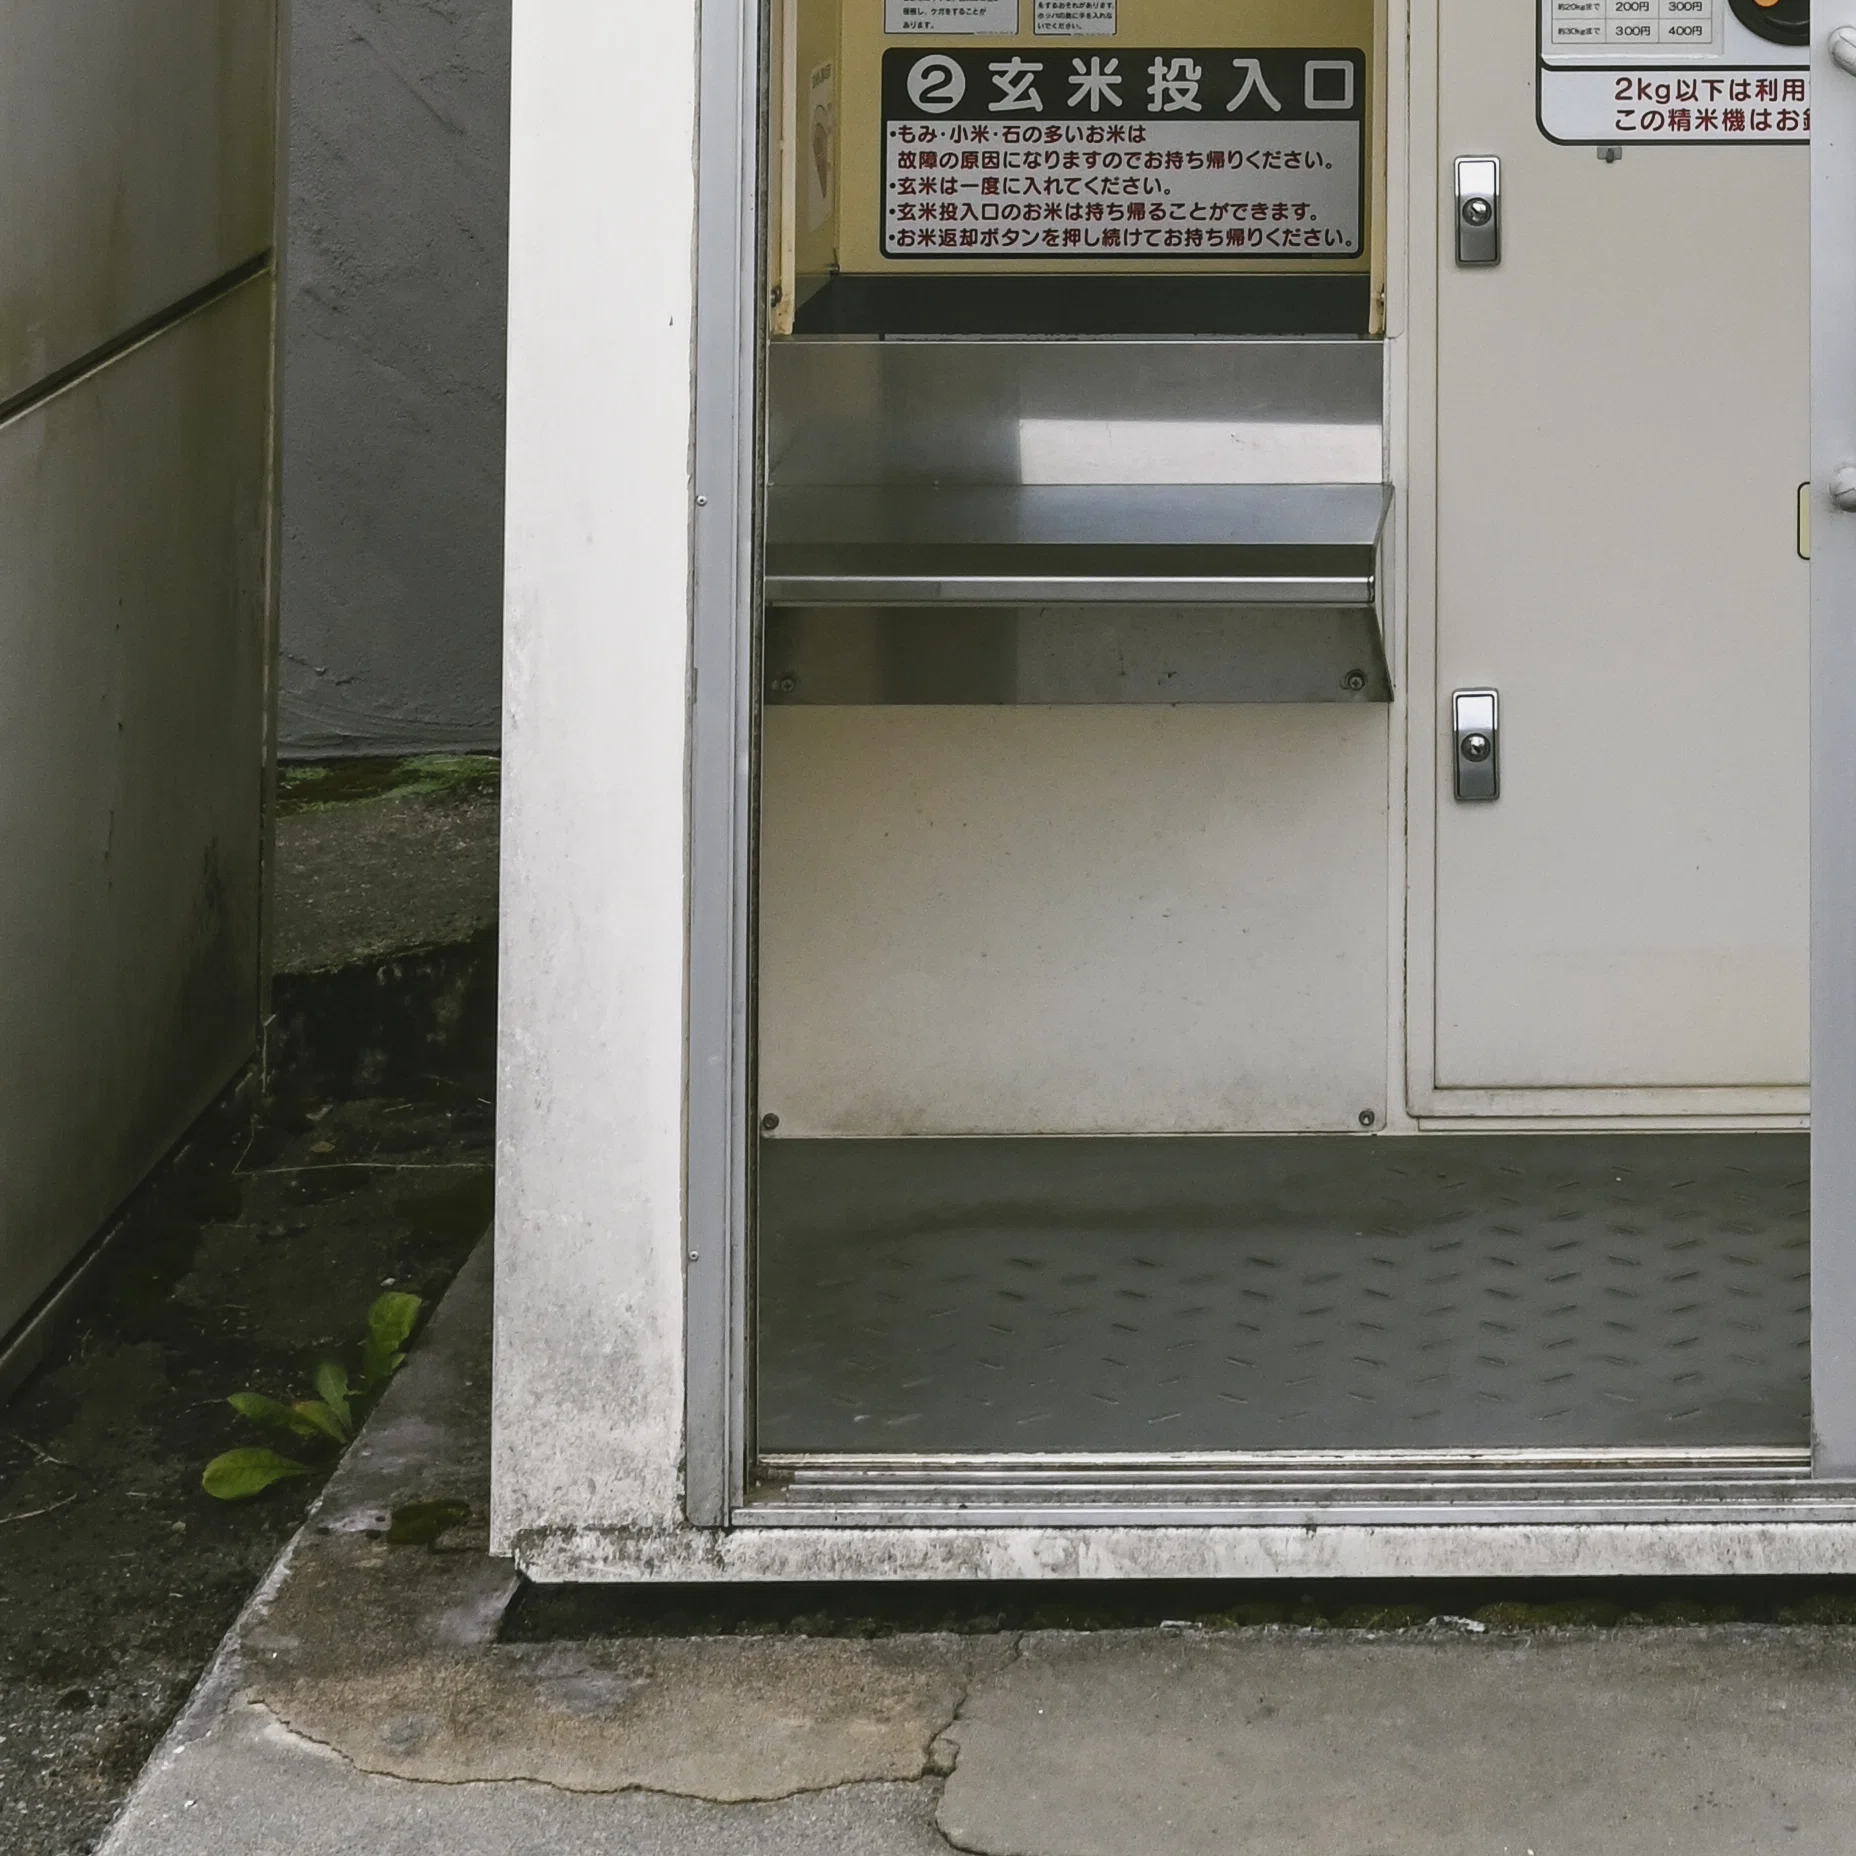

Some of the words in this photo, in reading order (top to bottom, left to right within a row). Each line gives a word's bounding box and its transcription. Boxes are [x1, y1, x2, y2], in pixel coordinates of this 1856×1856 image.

[1615, 1, 1650, 13] 200円
[1668, 1, 1703, 13] 300円
[1615, 25, 1651, 37] 300円
[1668, 25, 1703, 37] 400円
[987, 55, 1355, 113] 玄米投入口
[1614, 77, 1810, 105] 2kg以下は利用
[897, 149, 1334, 171] 故障の原因になりますのでお持ち帰りください。
